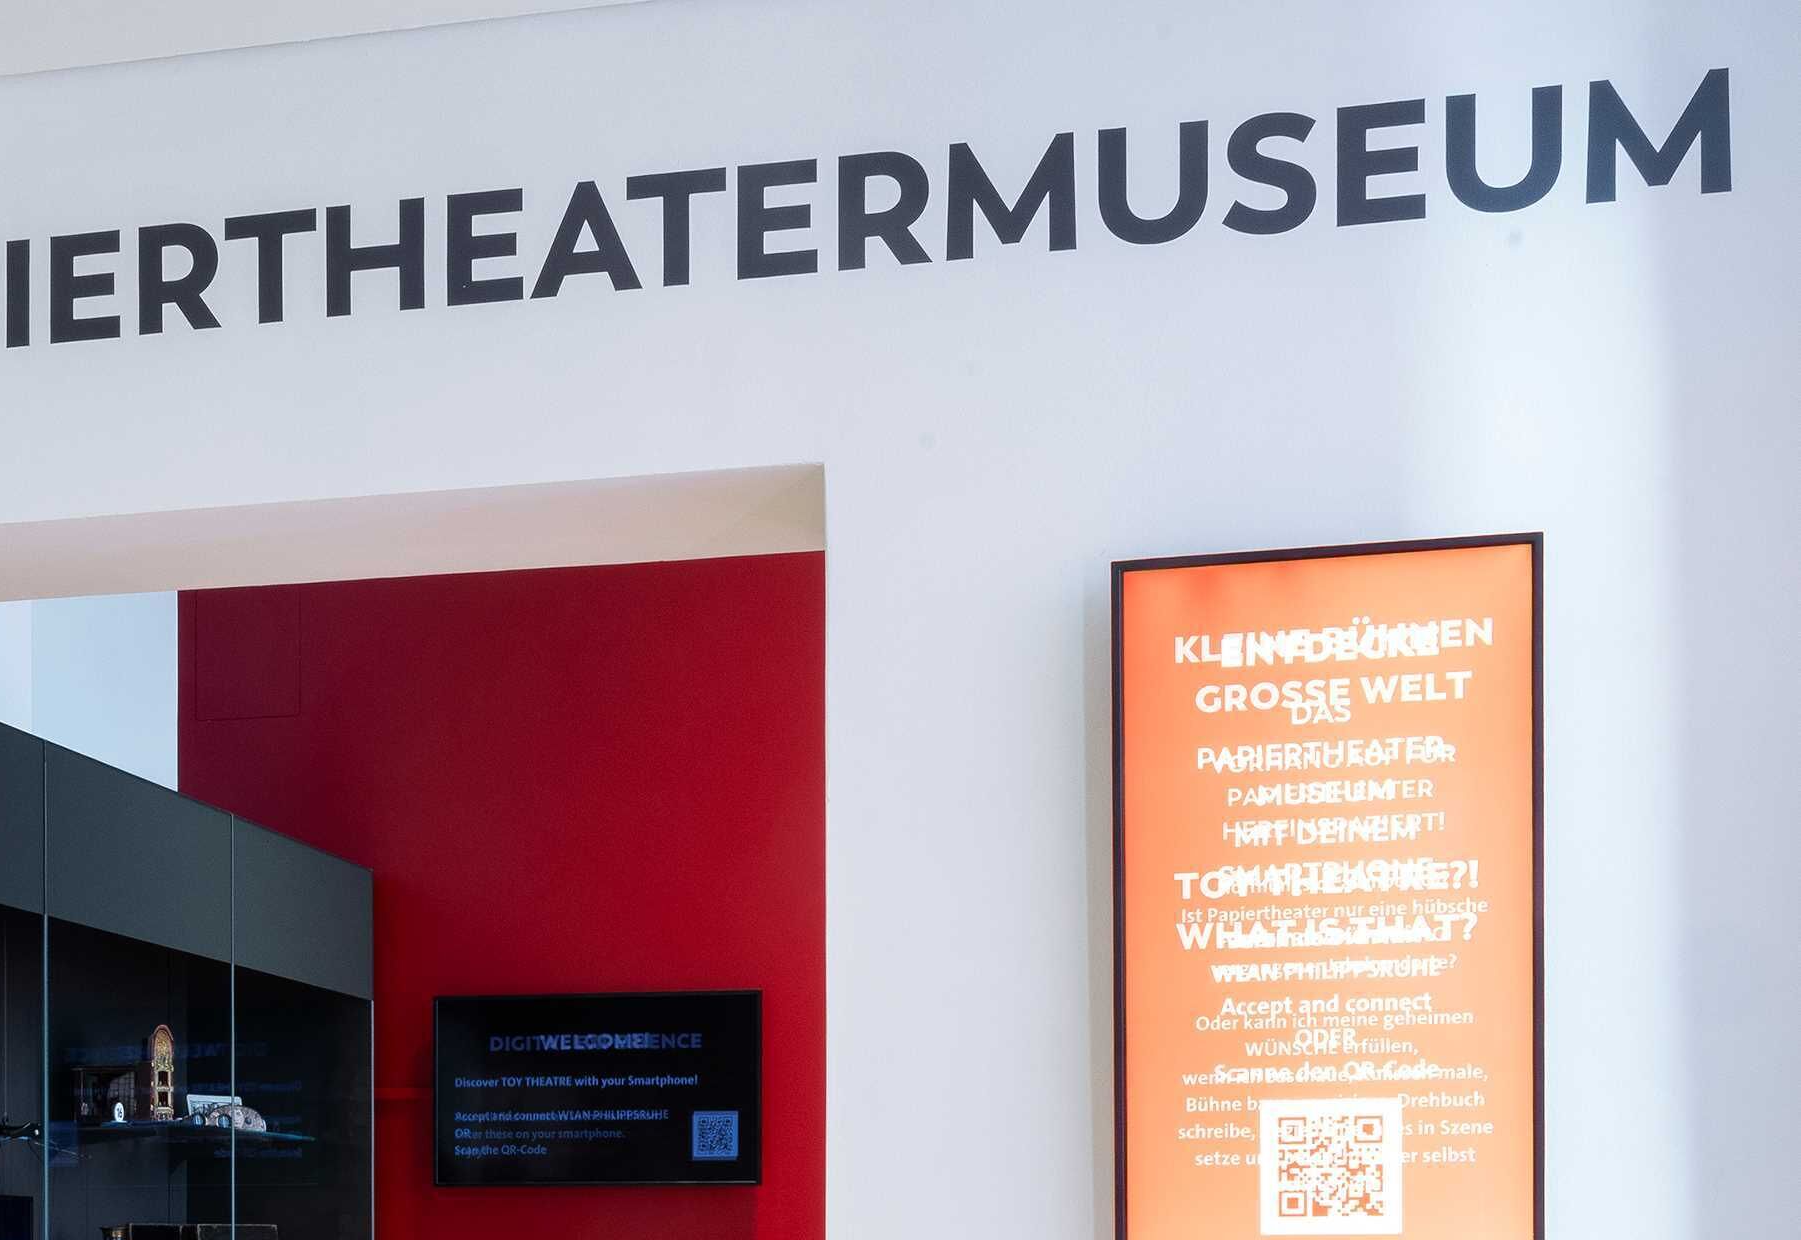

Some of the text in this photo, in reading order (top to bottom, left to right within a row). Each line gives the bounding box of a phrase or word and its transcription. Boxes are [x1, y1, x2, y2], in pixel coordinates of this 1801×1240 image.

[1195, 671, 1472, 713] GROSSE WELT
[1291, 701, 1351, 725] DAS
[1182, 897, 1489, 926] Ist Papiertheater nur eine hübsche
[1176, 918, 1296, 951] WHAT
[1221, 992, 1432, 1022] Accept and connect
[1196, 1015, 1238, 1031] Oder
[1292, 1010, 1318, 1029] ich
[1323, 1011, 1378, 1027] meine
[1383, 1008, 1474, 1030] geheimen
[1343, 1037, 1419, 1055] erfüllen,
[455, 1074, 698, 1089] Discover TOY THEATRE with your Smartphone!
[1186, 1095, 1242, 1113] Bühne
[1178, 1121, 1256, 1141] schreibe,
[1418, 1119, 1435, 1135] in
[1439, 1119, 1494, 1135] Szene
[501, 1145, 548, 1156] QR-Code
[1195, 1150, 1241, 1166] setze
[1422, 1145, 1477, 1163] selbst
